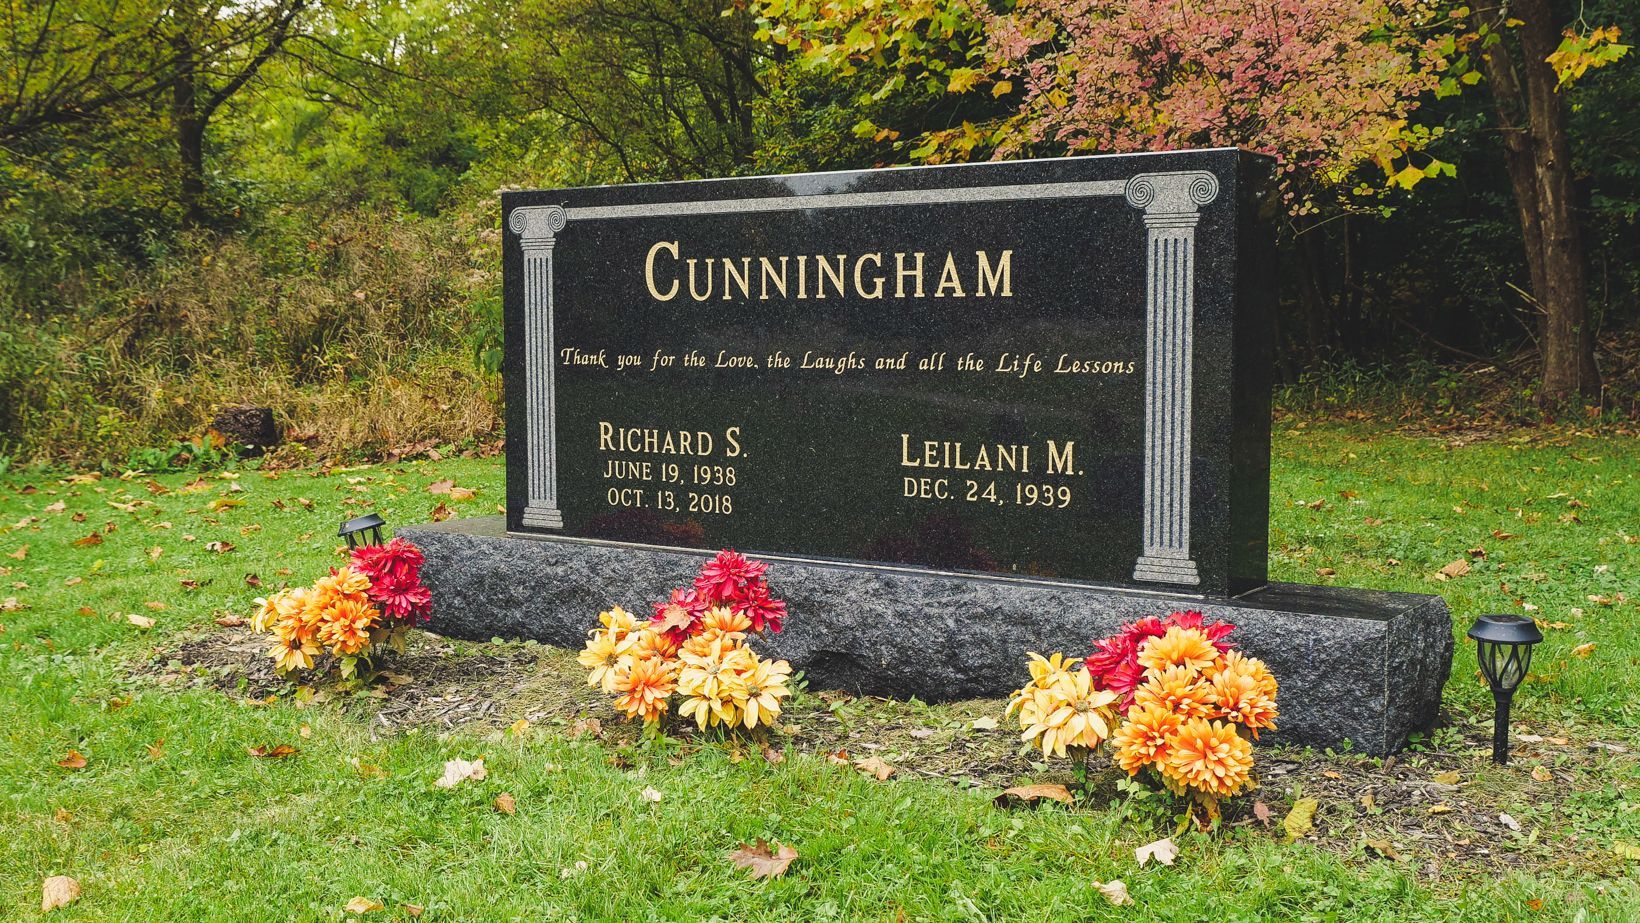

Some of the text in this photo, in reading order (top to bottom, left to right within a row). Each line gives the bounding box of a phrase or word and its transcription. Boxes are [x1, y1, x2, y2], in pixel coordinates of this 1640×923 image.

[645, 240, 1013, 302] CUNNINGHAM
[560, 346, 609, 369] Thank
[616, 354, 642, 371] you
[649, 349, 676, 372] for
[683, 349, 706, 367] the
[766, 350, 791, 369] the
[799, 350, 866, 375] Laughs
[875, 351, 906, 370] and
[918, 352, 947, 371] all
[957, 352, 985, 372] the
[994, 352, 1042, 379] Life
[1053, 353, 1135, 374] Lessons
[598, 421, 748, 458] RICHARD S.
[900, 433, 1084, 476] LEILANI M.
[603, 460, 736, 487] JUNE 19, 1938
[607, 487, 733, 515] OCT. 13, 2018
[903, 476, 1071, 509] DEC. 24, 1939
